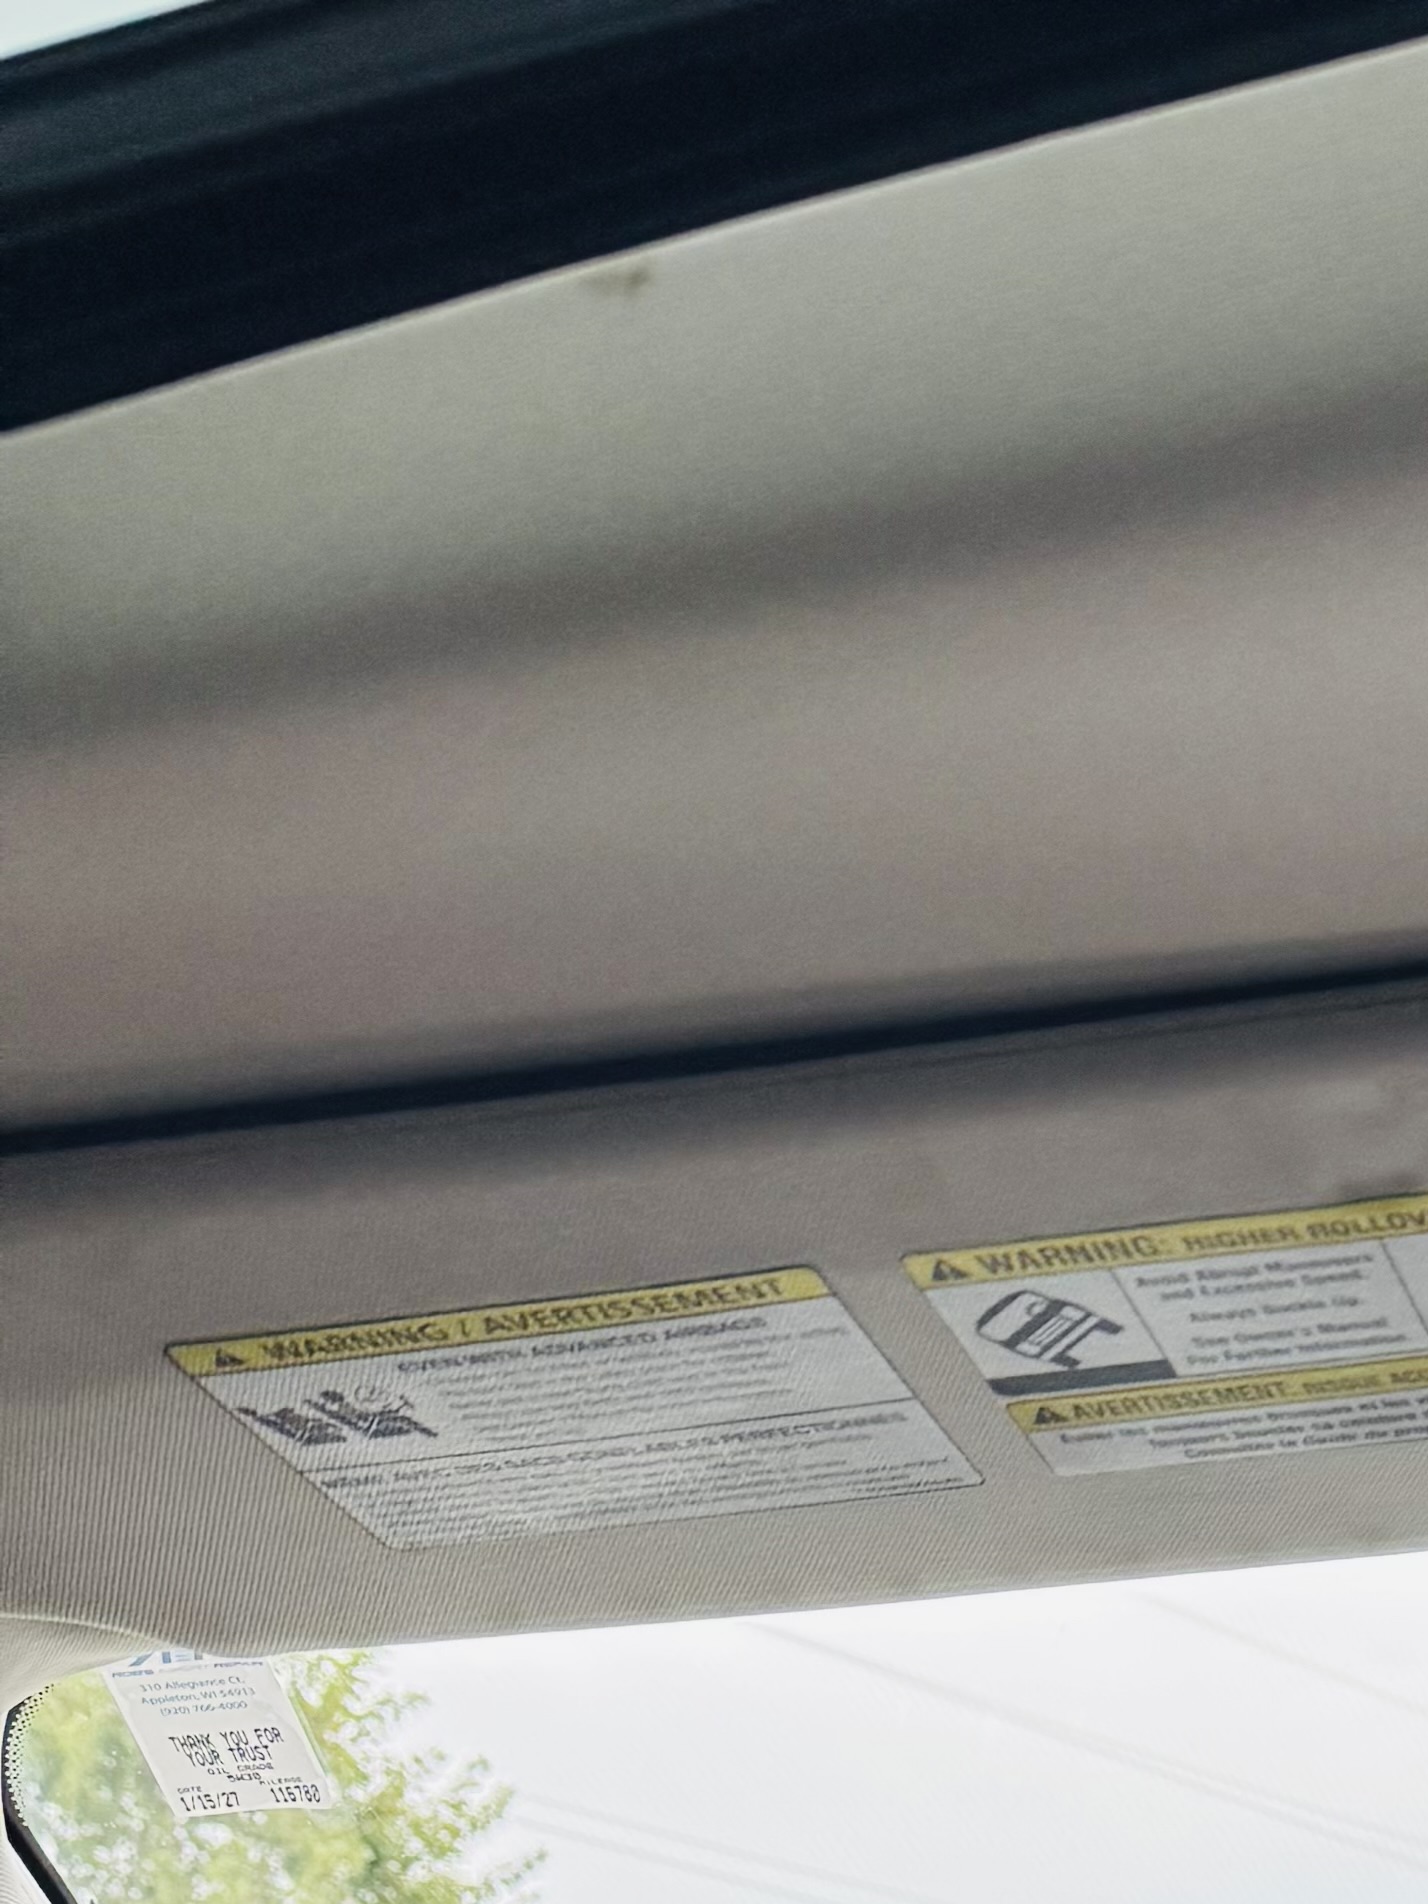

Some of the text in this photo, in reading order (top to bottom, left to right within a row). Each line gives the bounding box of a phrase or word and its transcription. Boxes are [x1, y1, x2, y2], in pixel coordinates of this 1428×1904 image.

[1179, 1223, 1305, 1252] HIGHER
[255, 1323, 452, 1361] WARNING
[471, 1279, 790, 1335] AVERTISSEMENT
[200, 1689, 217, 1700] WI
[168, 1727, 284, 1752] THANK YOU FOR
[184, 1745, 273, 1767] YOUR TRUST
[207, 1767, 229, 1775] OIL
[180, 1791, 240, 1812] 1/15/27
